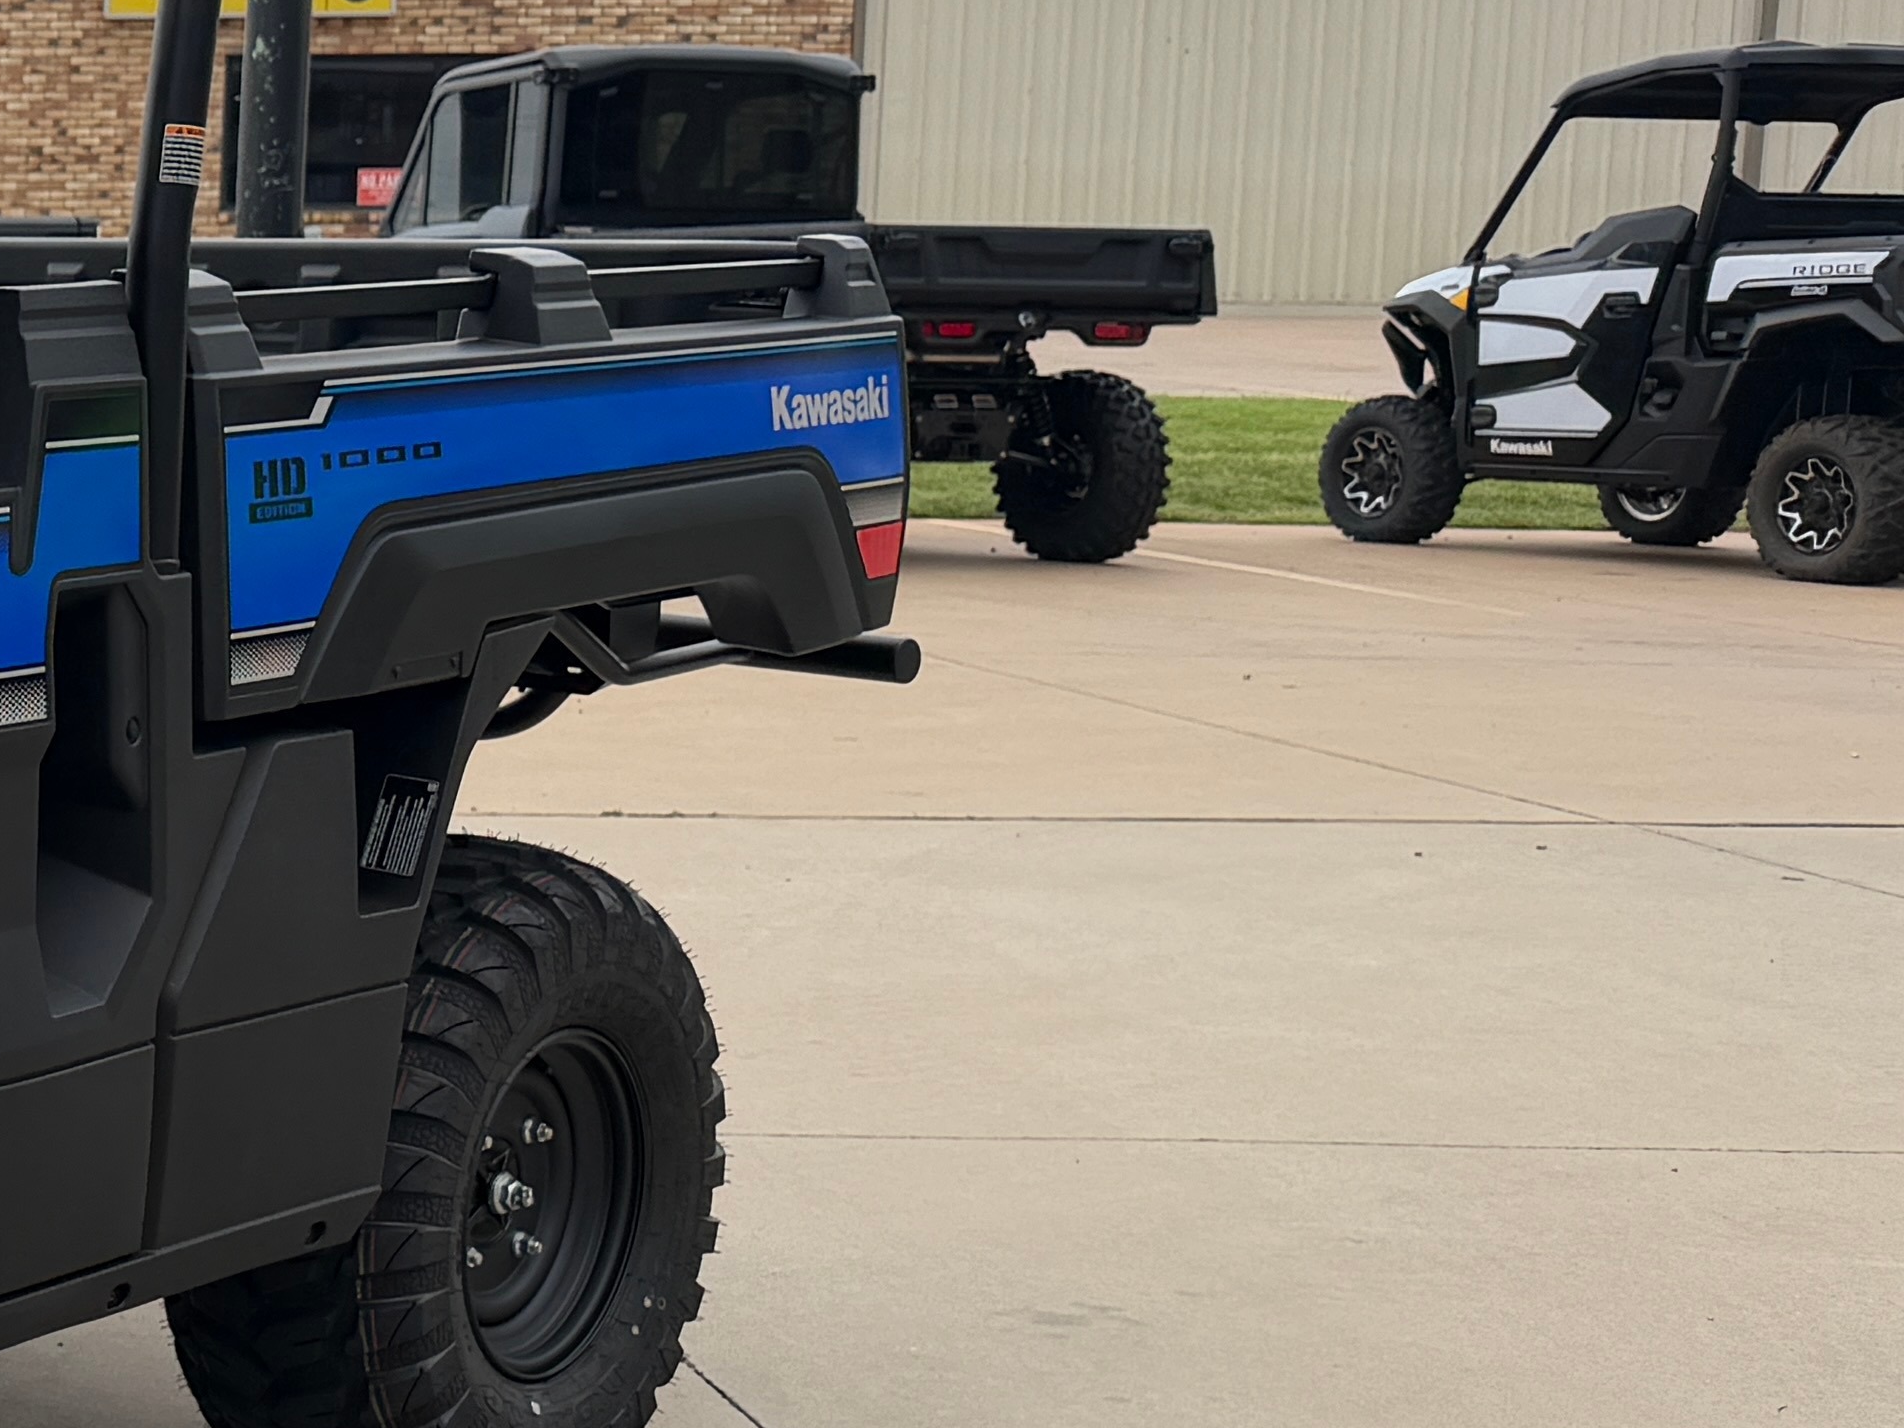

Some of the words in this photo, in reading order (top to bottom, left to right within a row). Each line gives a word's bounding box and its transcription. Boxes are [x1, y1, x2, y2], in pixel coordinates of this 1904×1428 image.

[1792, 263, 1867, 276] RIDGE
[770, 374, 890, 432] Kawasaki
[1489, 437, 1553, 457] Kawasaki
[253, 456, 307, 500] HD
[320, 441, 442, 470] 1000
